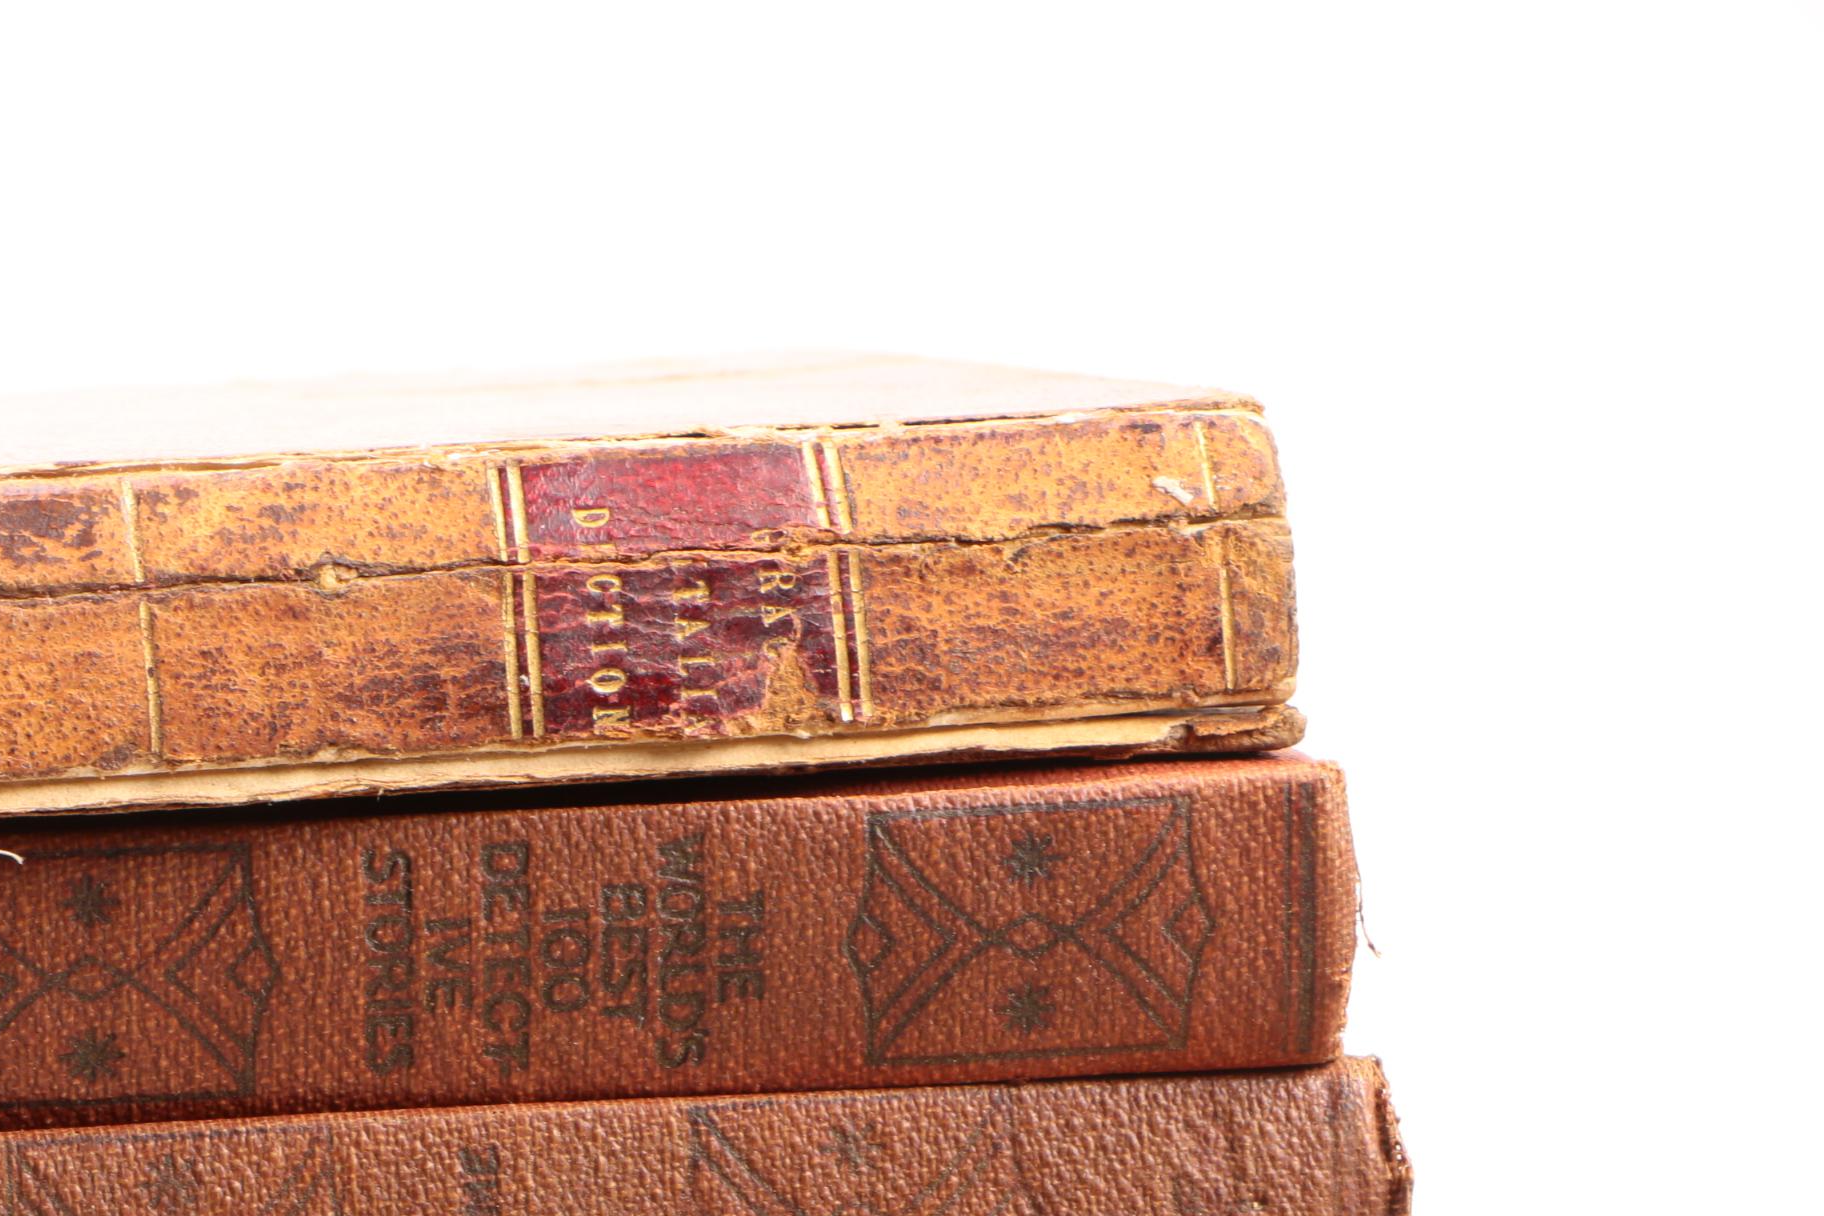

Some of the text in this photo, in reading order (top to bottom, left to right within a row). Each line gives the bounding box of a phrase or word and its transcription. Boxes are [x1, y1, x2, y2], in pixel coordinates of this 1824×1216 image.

[360, 848, 415, 1076] STORIES
[424, 916, 474, 1016] IVE
[479, 840, 531, 1077] DETECT-
[539, 905, 592, 1014] 100
[600, 881, 649, 1030] BEST
[655, 832, 709, 1070] WORLD'S
[716, 889, 765, 1003] THE
